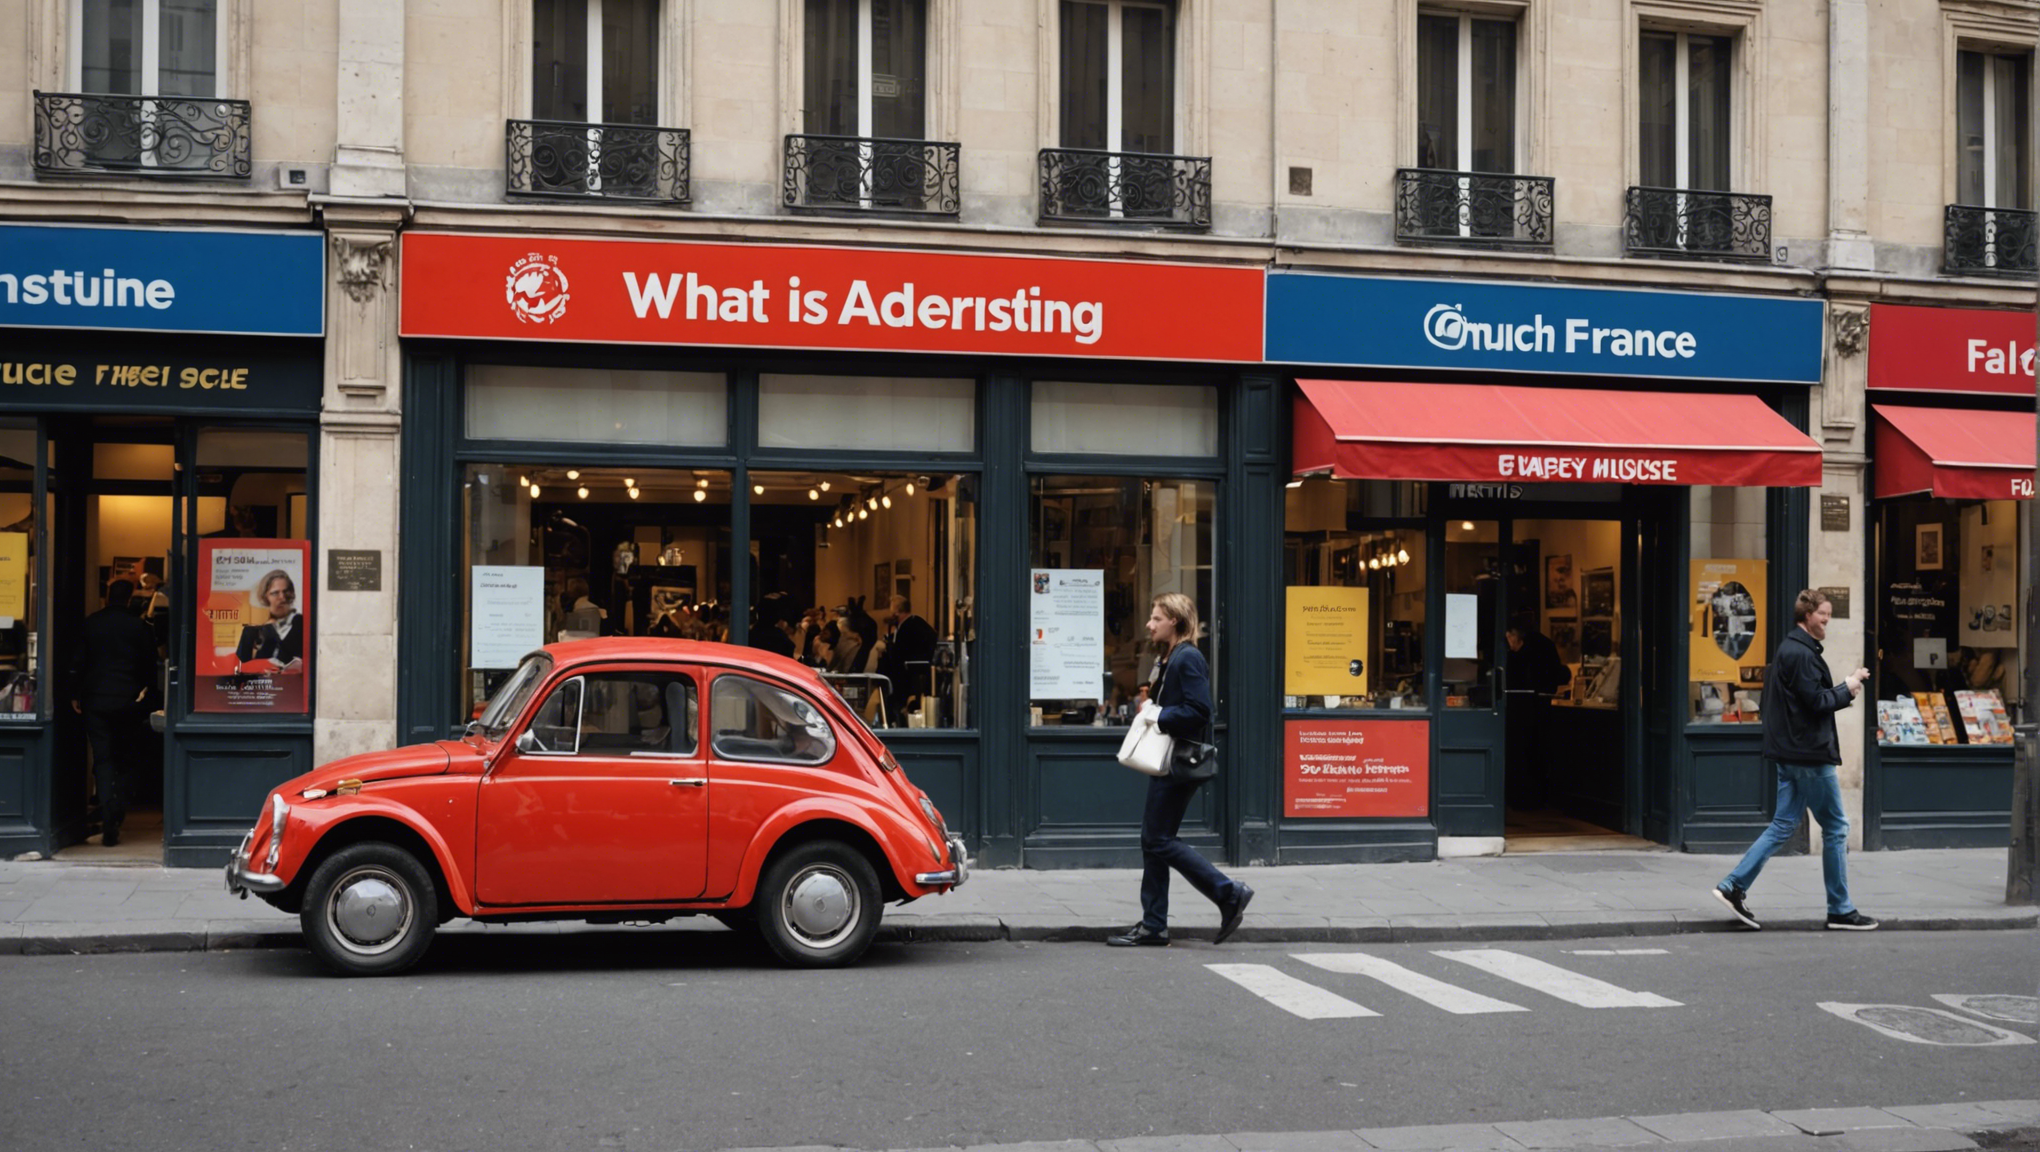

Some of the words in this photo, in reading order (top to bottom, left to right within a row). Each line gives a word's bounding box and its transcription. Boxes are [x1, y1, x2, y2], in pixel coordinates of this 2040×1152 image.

[622, 271, 769, 324] What
[788, 276, 828, 325] is
[1565, 318, 1698, 358] France
